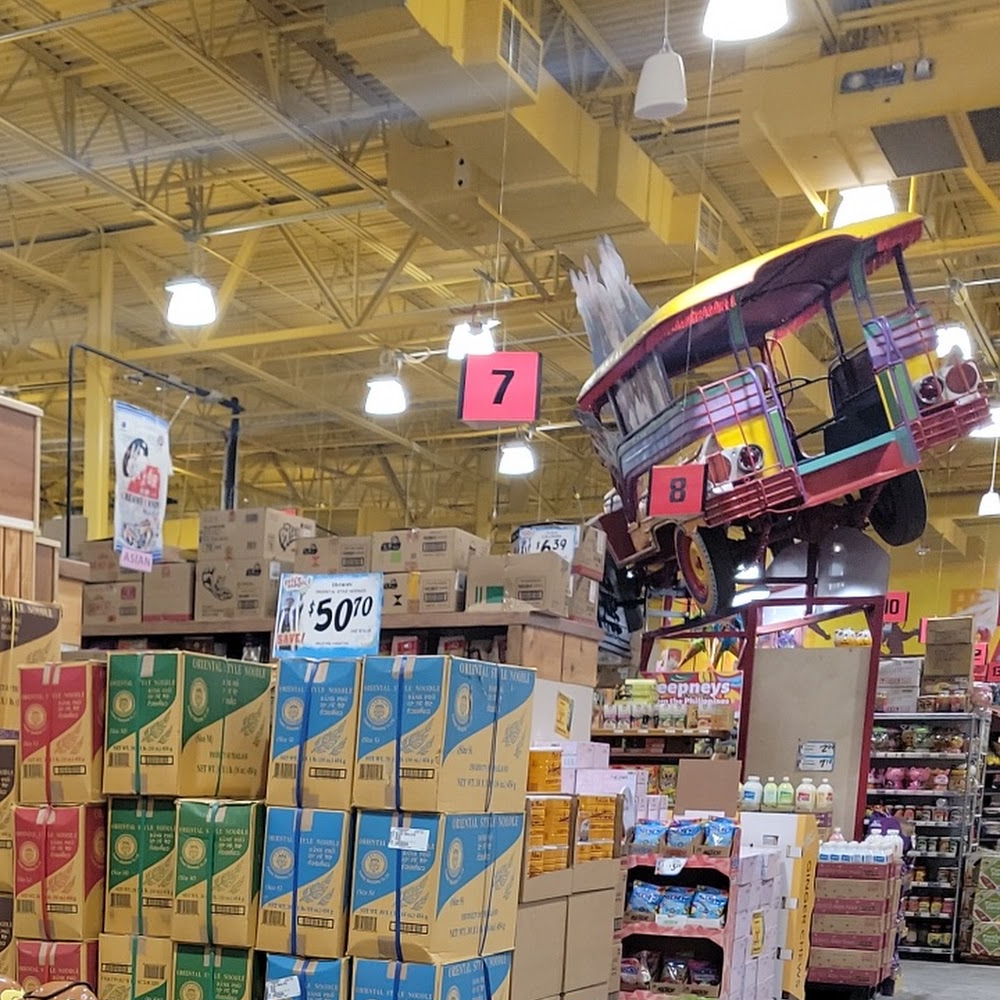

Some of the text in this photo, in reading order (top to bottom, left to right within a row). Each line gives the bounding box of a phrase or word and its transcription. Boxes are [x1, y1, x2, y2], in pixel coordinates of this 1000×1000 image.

[491, 369, 515, 404] 7
[669, 478, 686, 503] 8
[123, 549, 151, 567] ASIAN
[276, 632, 305, 645] SAVE!
[657, 682, 731, 702] eepneys
